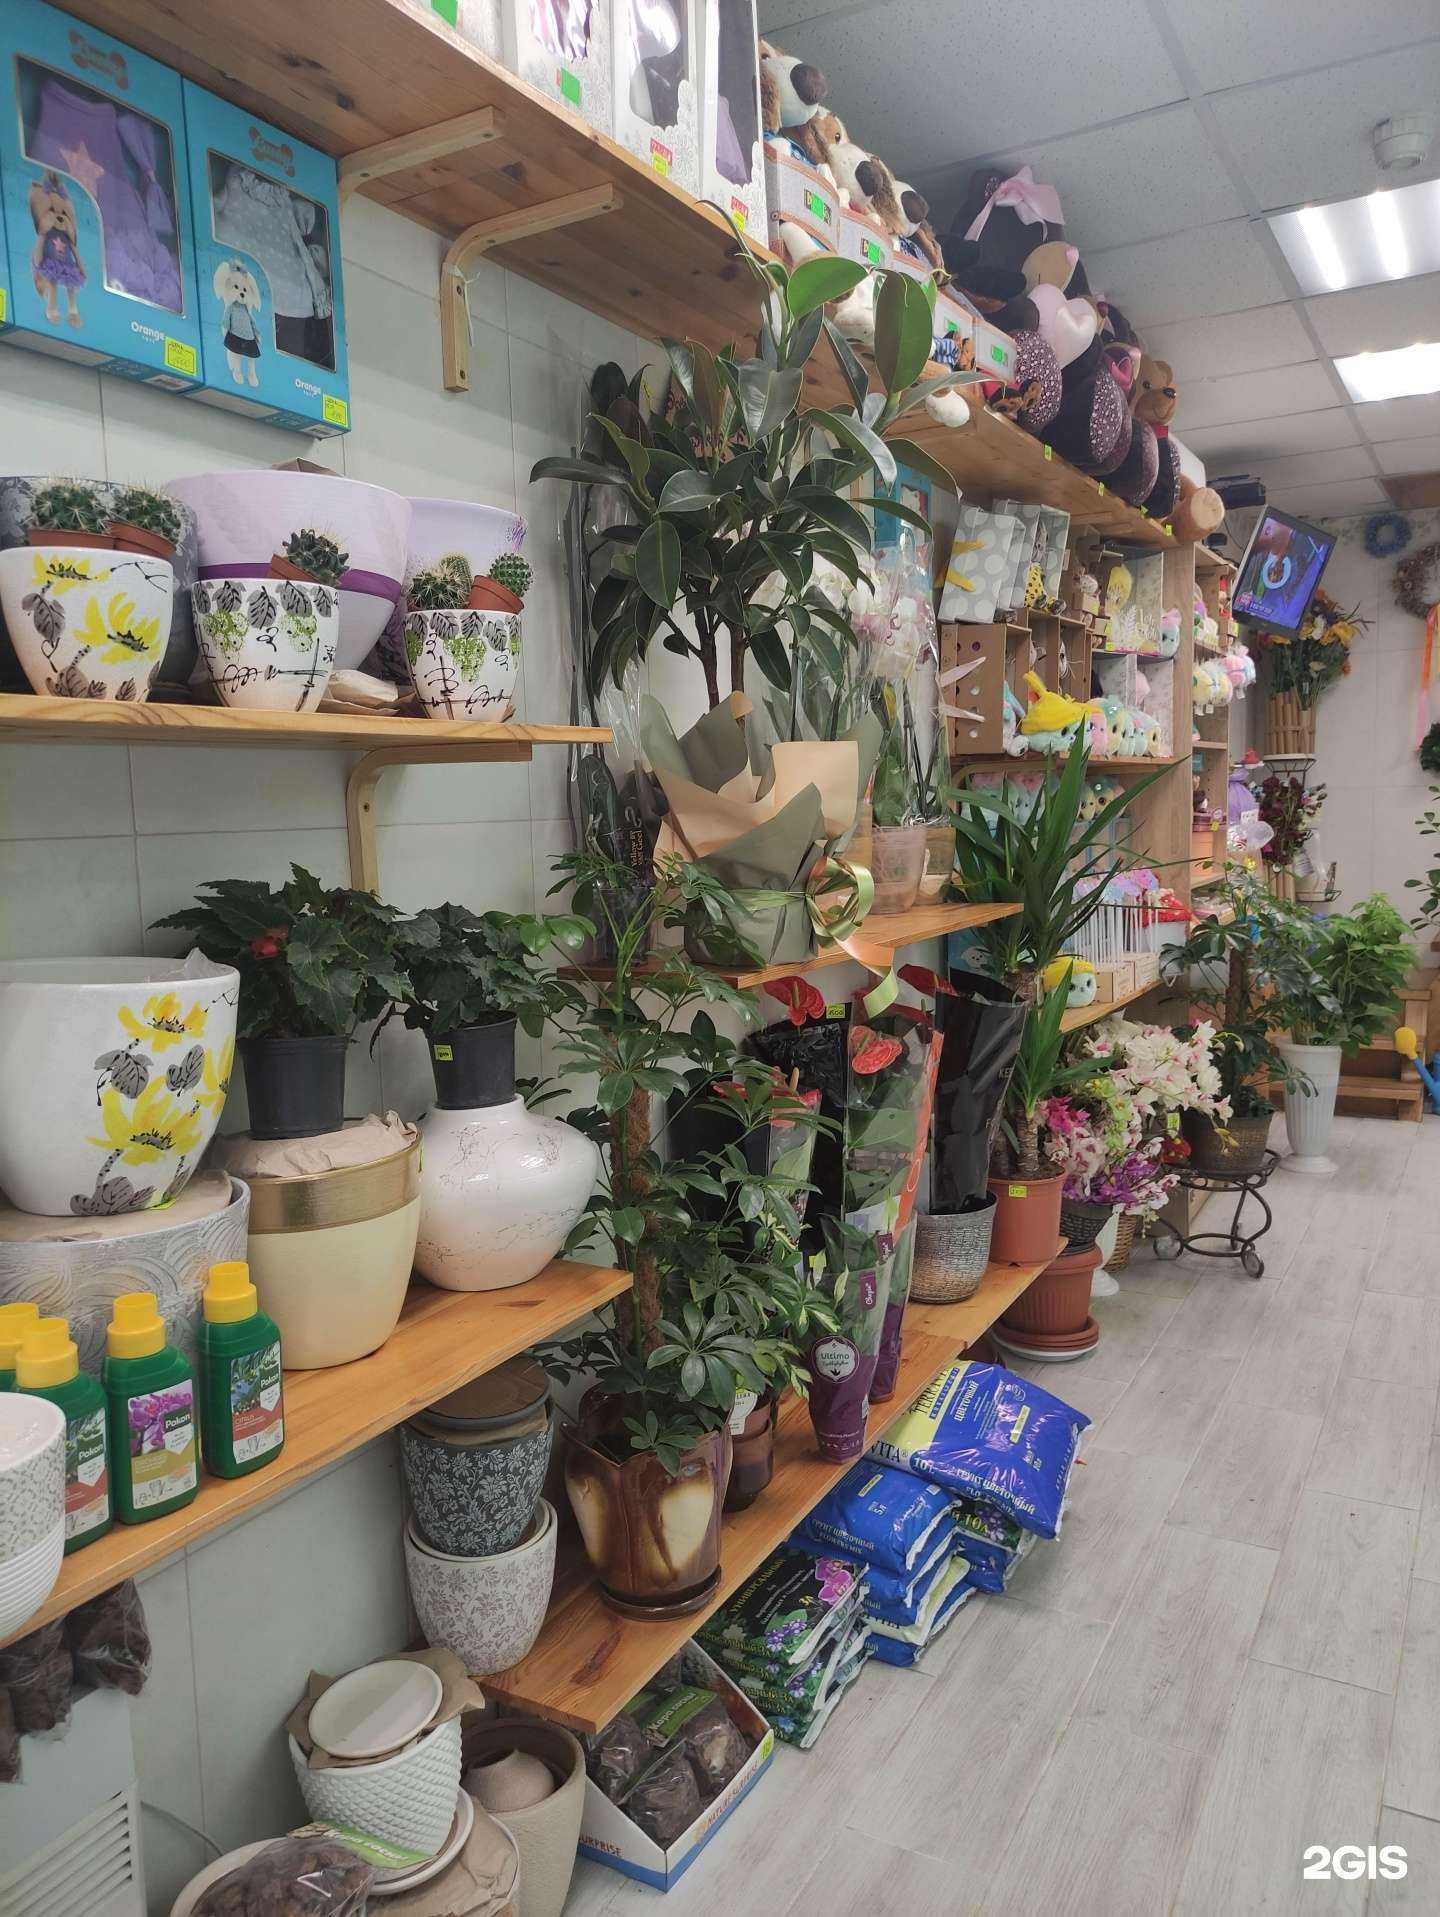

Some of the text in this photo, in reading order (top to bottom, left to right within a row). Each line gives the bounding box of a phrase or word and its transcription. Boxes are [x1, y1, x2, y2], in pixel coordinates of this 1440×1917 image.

[131, 321, 165, 341] Orange
[295, 378, 321, 395] Orange
[260, 1373, 279, 1388] Pokon
[165, 1413, 191, 1429] Pokon
[79, 1445, 103, 1460] Pokon
